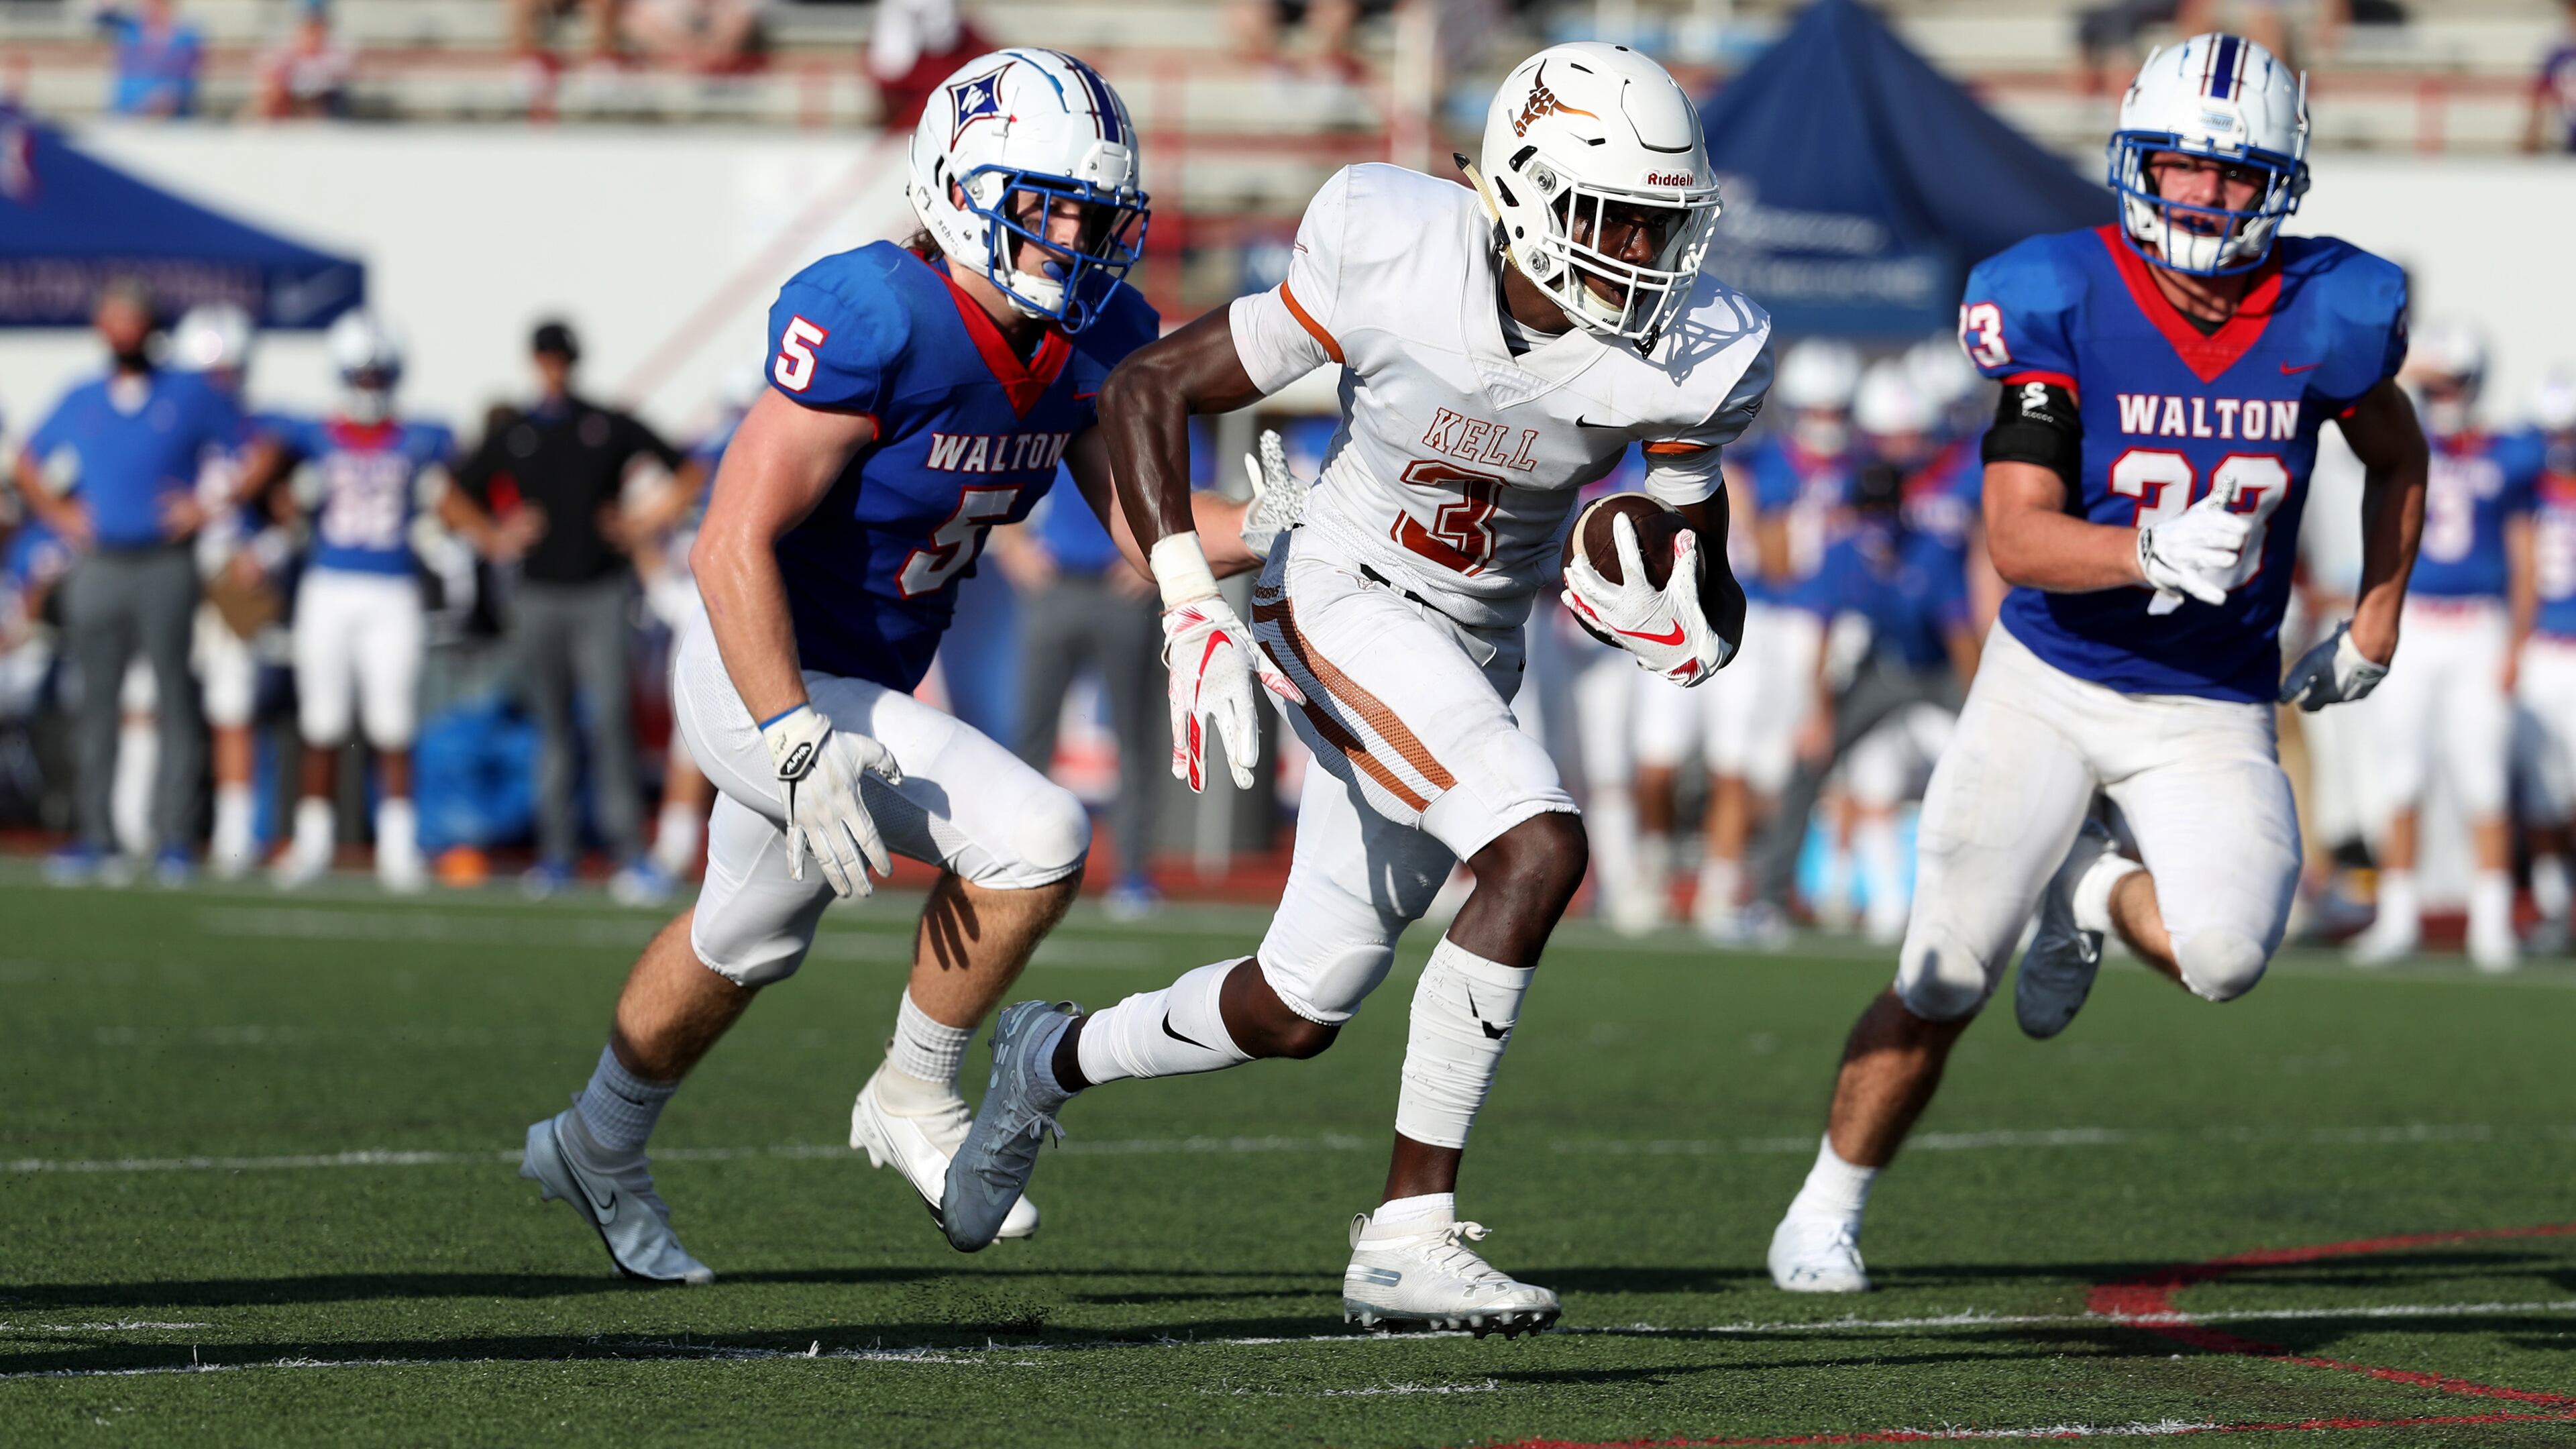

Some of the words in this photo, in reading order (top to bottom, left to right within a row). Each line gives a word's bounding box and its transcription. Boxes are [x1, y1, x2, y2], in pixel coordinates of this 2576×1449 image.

[1648, 172, 1694, 186] Riddell
[773, 315, 828, 393] 5
[1422, 407, 1539, 472] KELL
[2116, 394, 2300, 441] WALTON
[926, 431, 1071, 474] WALTON
[894, 484, 1024, 601] 5
[1390, 458, 1512, 578] 3
[786, 745, 811, 774] ALPHA
